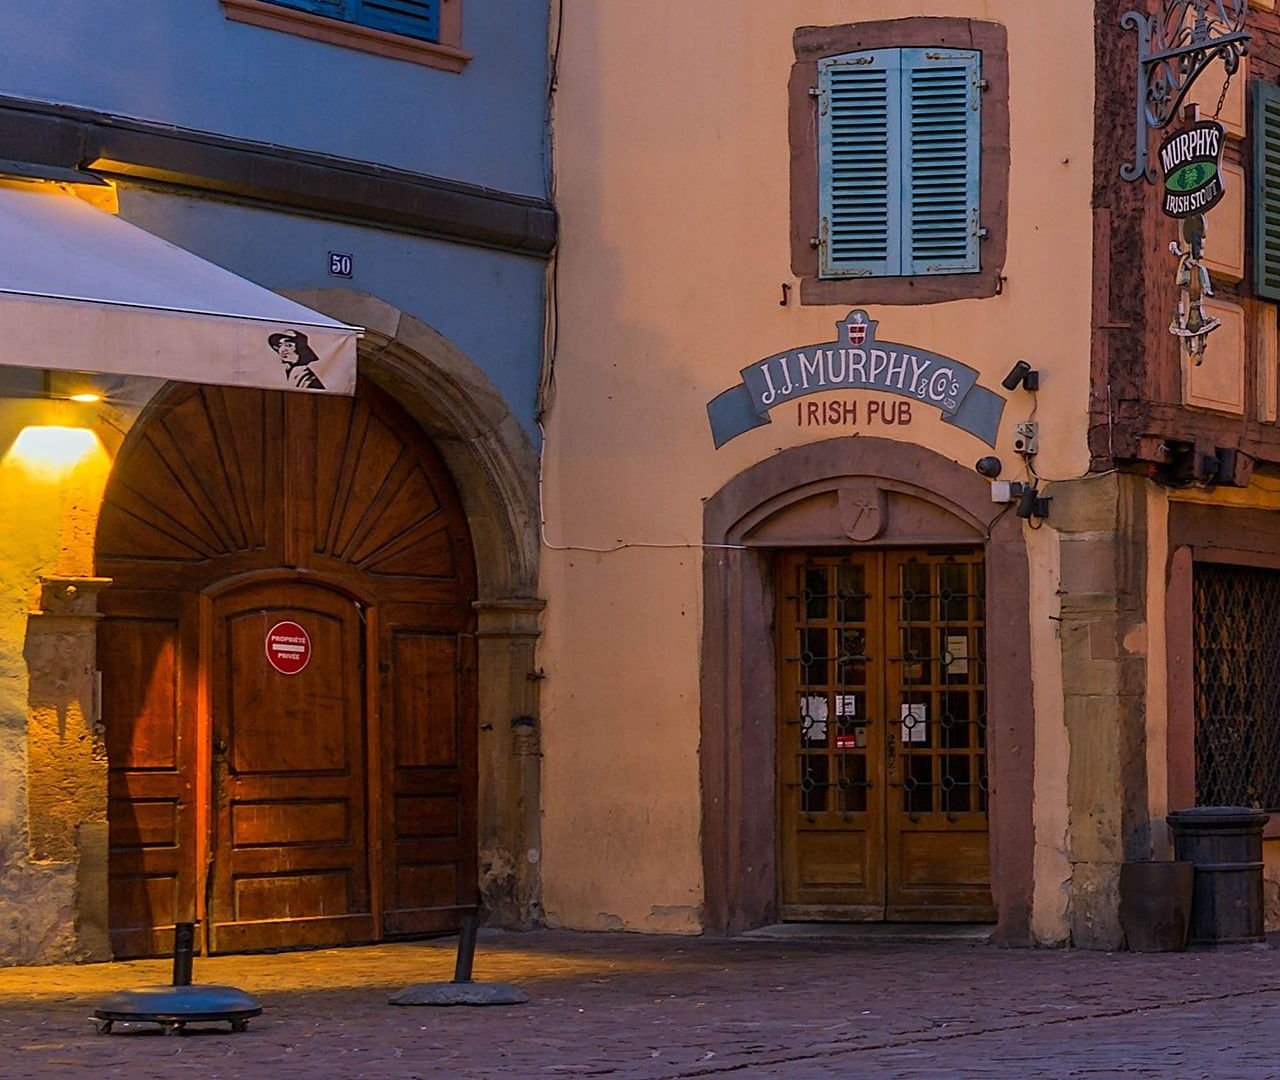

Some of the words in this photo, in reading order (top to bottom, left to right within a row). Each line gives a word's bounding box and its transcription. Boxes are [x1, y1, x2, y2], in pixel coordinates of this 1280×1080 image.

[1161, 127, 1220, 173] MURPHY'S
[1166, 194, 1189, 213] IRISH
[1190, 179, 1218, 210] STOUT
[332, 256, 351, 274] 50
[799, 349, 931, 394] MURPHY
[796, 401, 857, 426] IRISH
[867, 401, 912, 426] PUB
